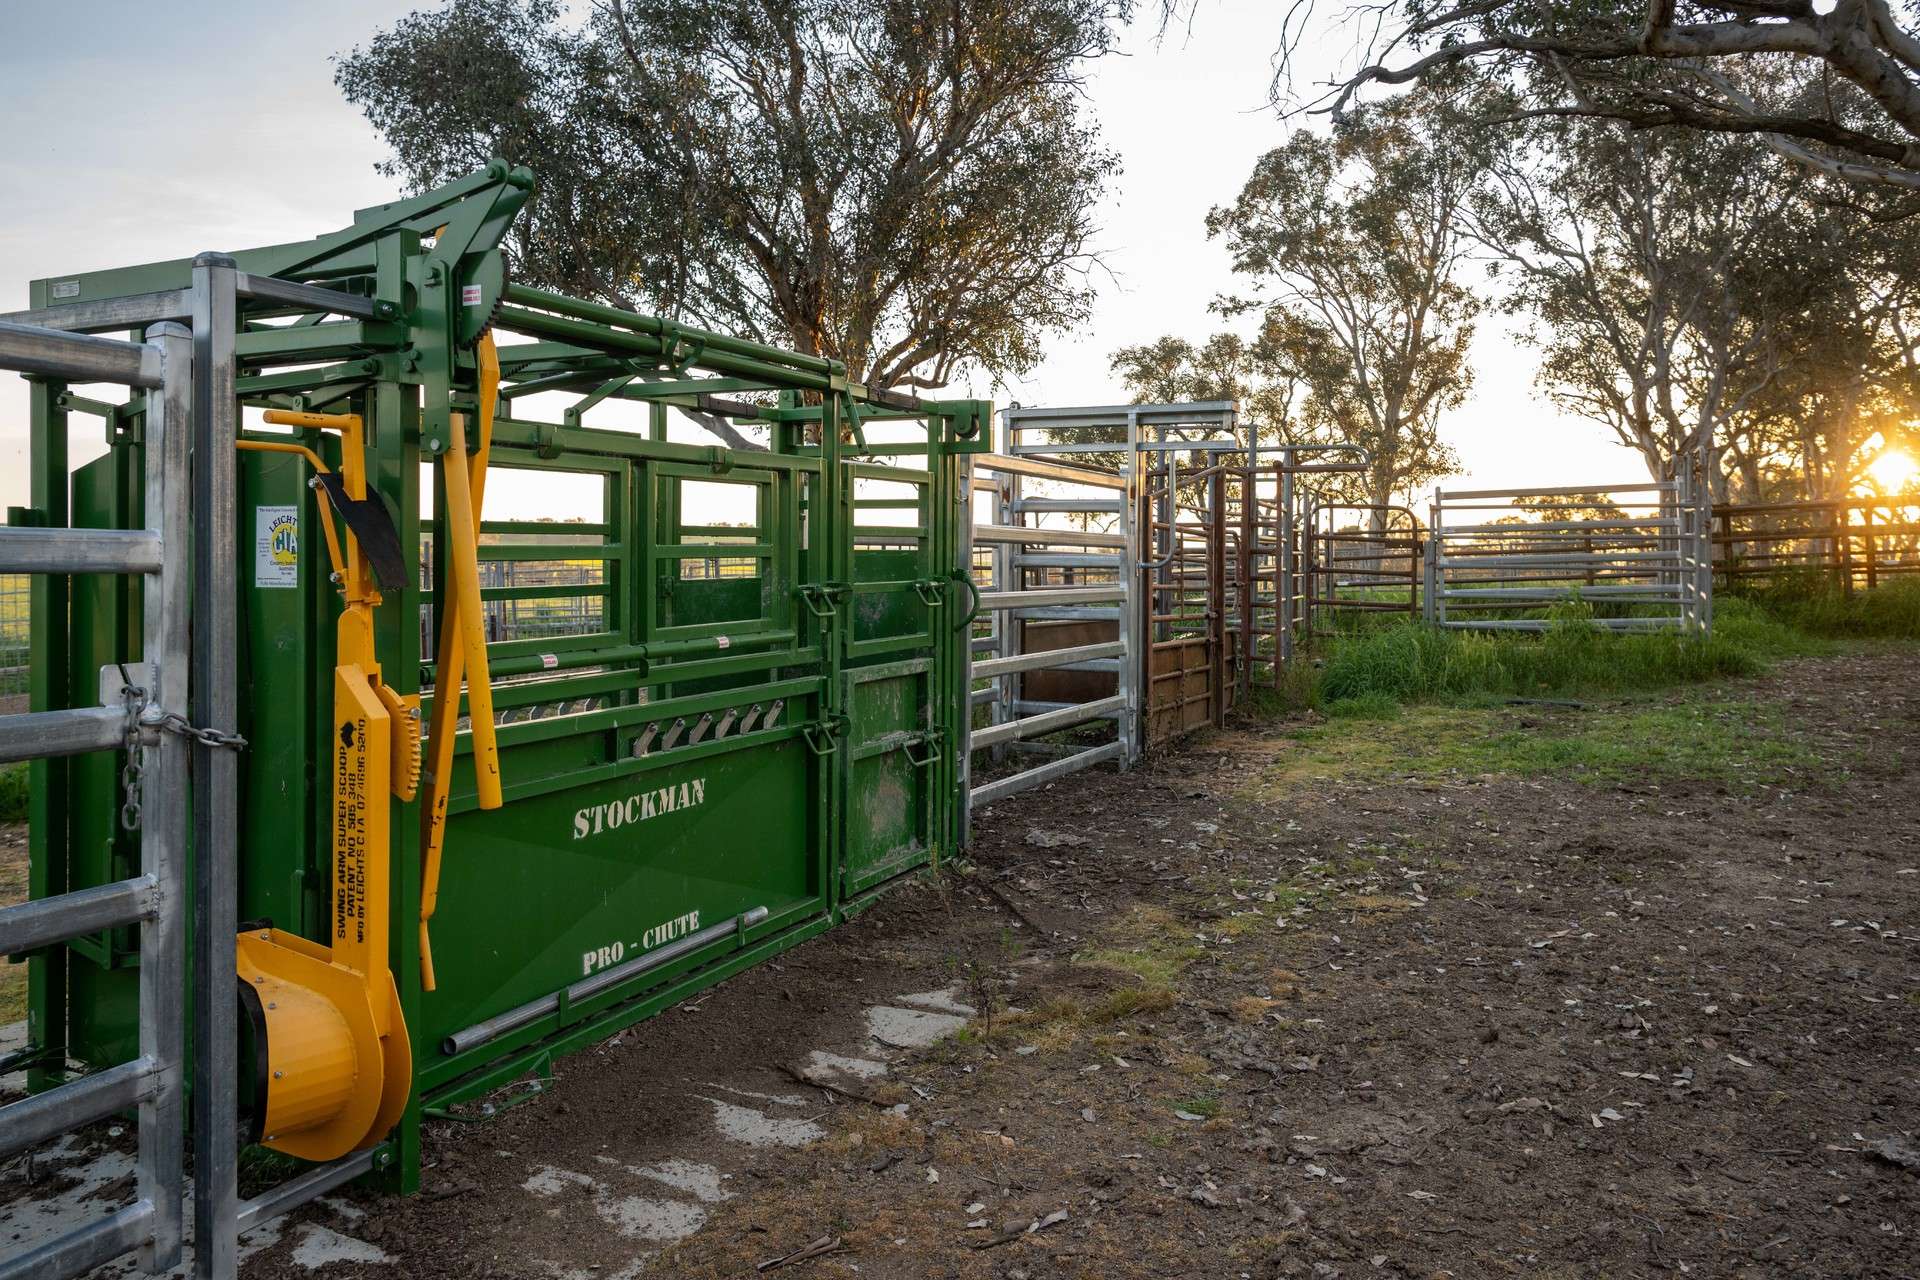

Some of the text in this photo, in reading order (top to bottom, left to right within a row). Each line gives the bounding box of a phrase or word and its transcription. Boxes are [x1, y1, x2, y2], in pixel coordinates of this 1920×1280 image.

[348, 772, 356, 800] 348
[357, 793, 365, 810] 07
[574, 778, 706, 839] STOCKMAN
[337, 745, 347, 939] SWING ARM SUPER SCOOP
[347, 837, 356, 858] NO
[347, 864, 355, 918] PATENT
[356, 849, 364, 902] LEICHTS
[357, 904, 364, 919] BY
[583, 941, 624, 975] PRO
[643, 910, 699, 949] CHUTE
